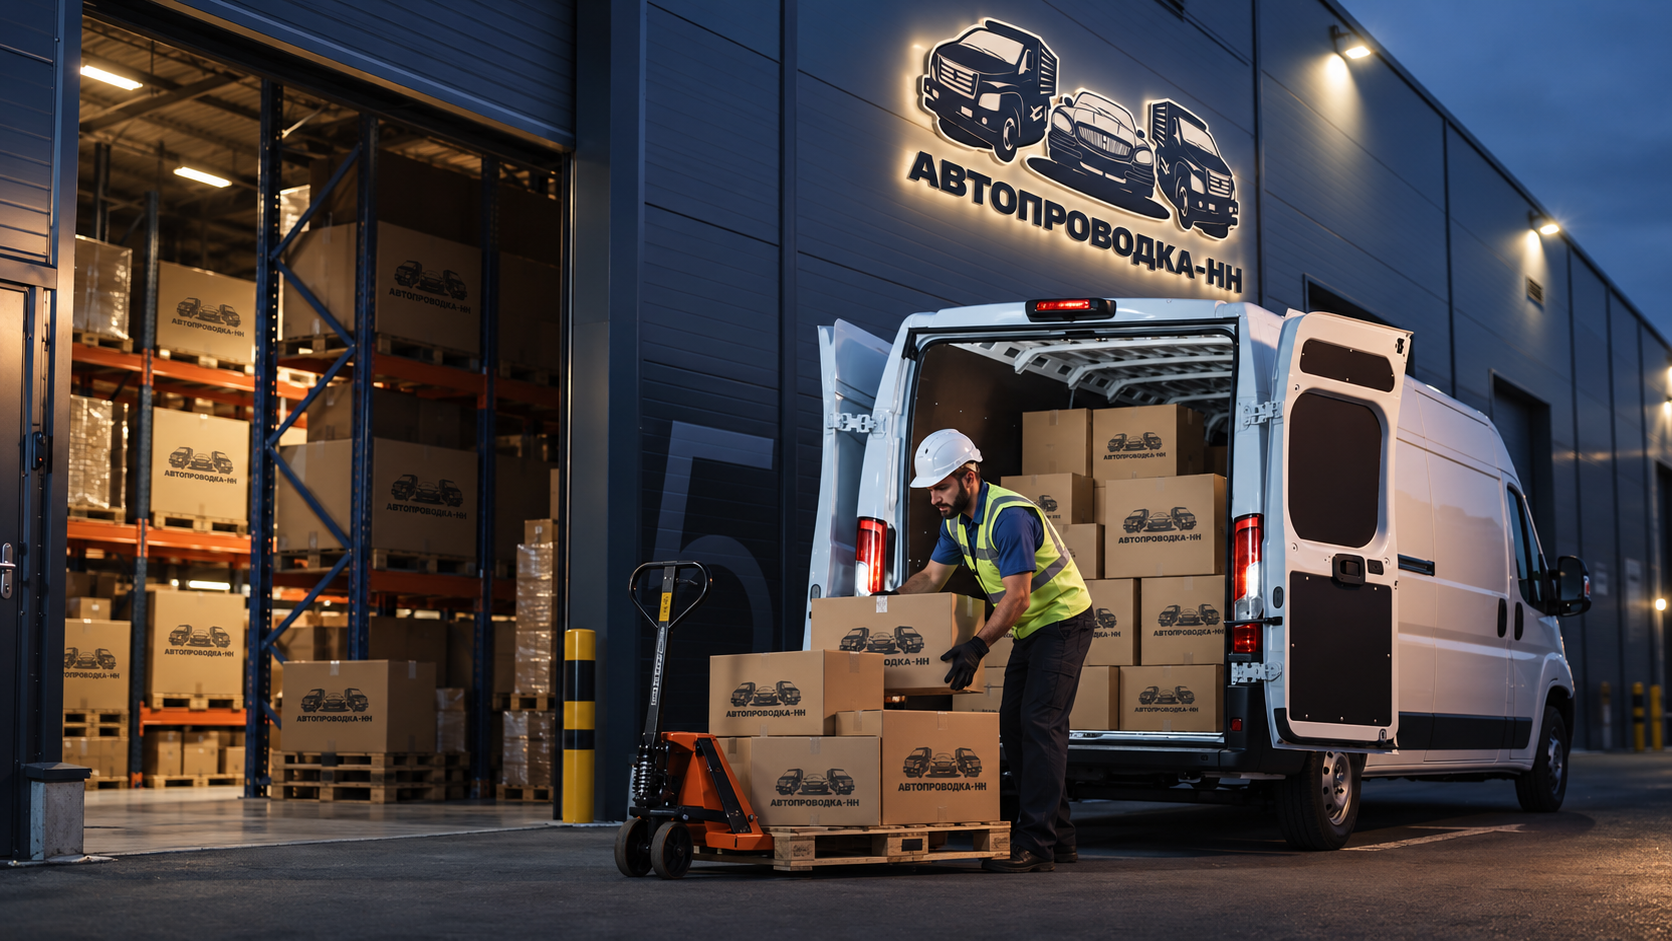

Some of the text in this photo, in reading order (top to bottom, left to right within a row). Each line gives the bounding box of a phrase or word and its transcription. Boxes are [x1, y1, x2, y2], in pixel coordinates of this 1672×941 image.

[908, 151, 1242, 293] АВТОПРОВОДКА-НН
[389, 287, 471, 314] АВТОПРОВОДКА-НН
[1118, 533, 1201, 544] АВТОПРОВОДКА-НН
[884, 657, 929, 667] ОДКА-НН
[725, 709, 806, 718] АВТОПРОВОДКА-НН
[296, 715, 373, 723] АВТОПРОВОДКА-НН
[897, 782, 987, 792] АВТОПРОВОДКА-НН
[770, 799, 860, 808] АВТОПРОВОДКА-НН
